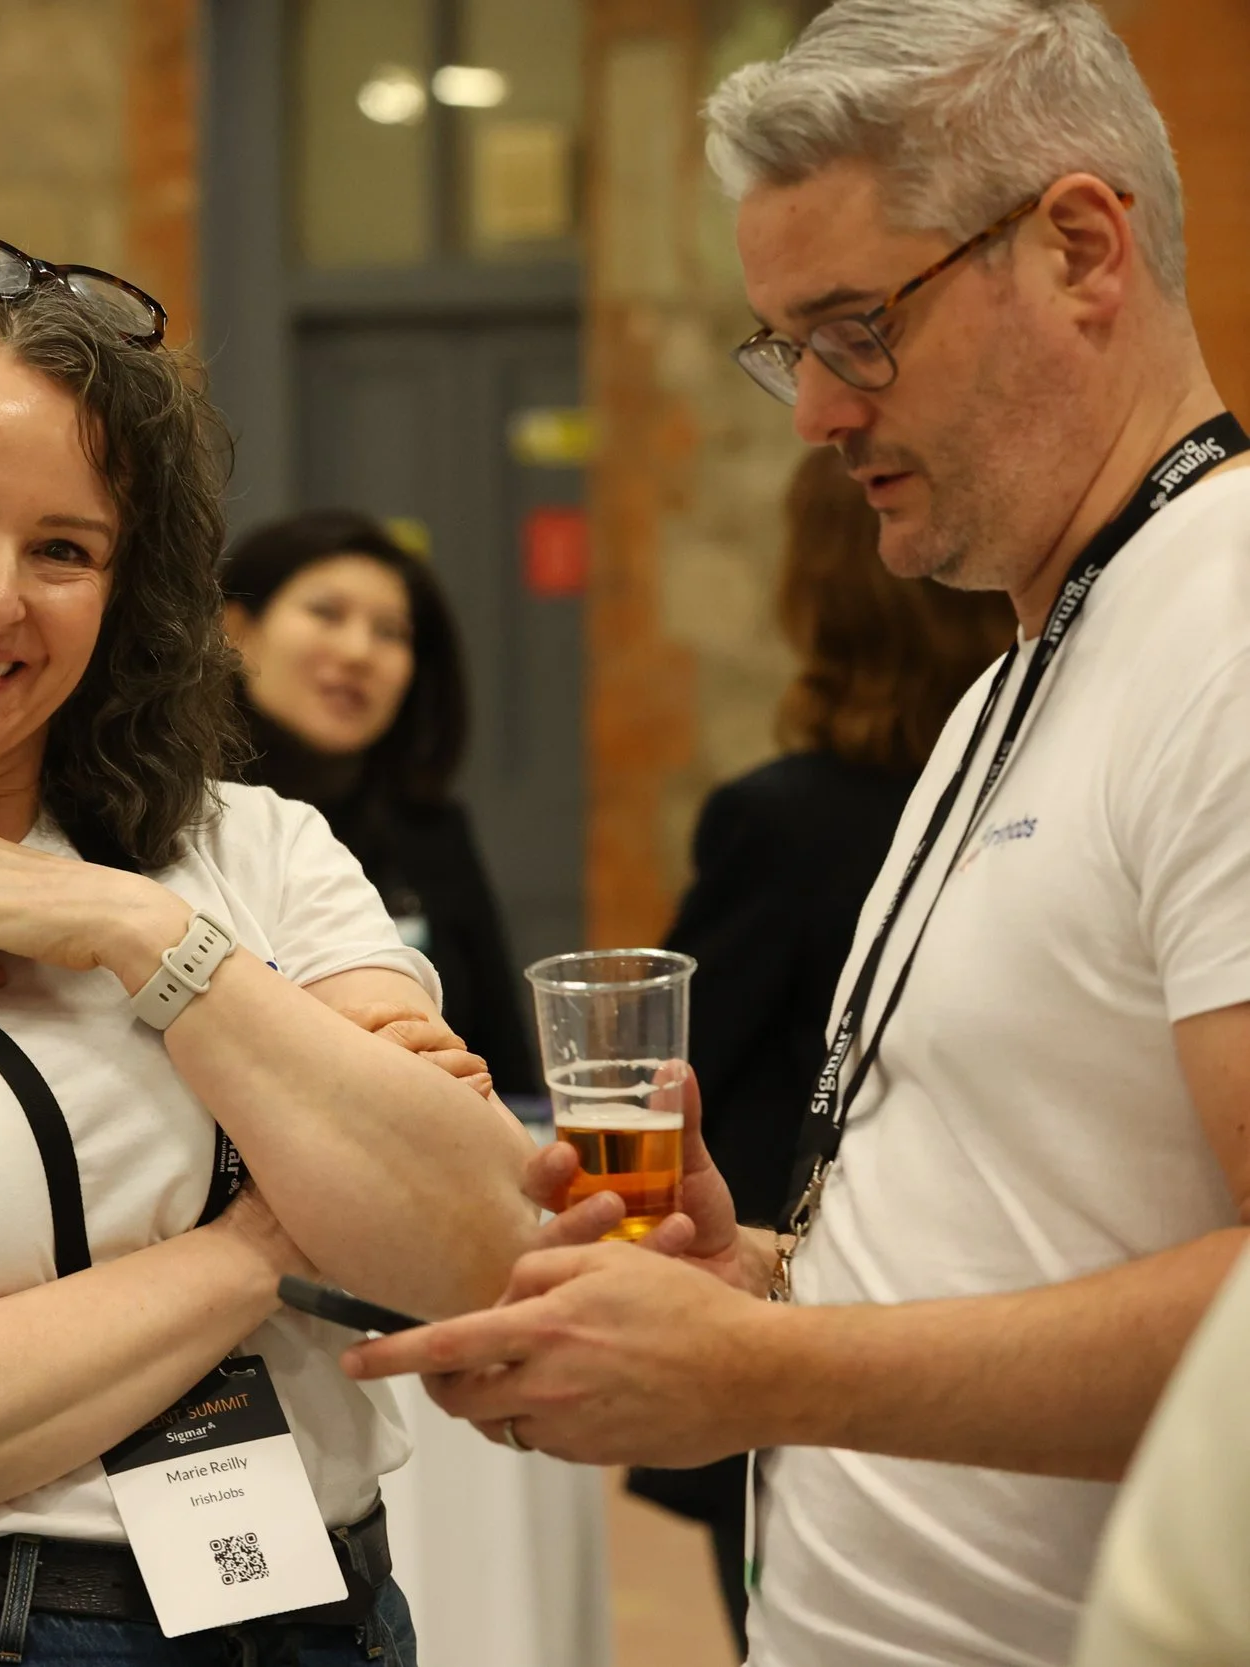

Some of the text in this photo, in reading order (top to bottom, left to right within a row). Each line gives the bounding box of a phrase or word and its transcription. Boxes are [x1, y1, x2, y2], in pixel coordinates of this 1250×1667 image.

[1158, 437, 1227, 493] Sigmar
[1048, 563, 1103, 646] Sigmar
[810, 1031, 848, 1115] Sigmar
[189, 1392, 250, 1420] SUMMIT
[166, 1425, 208, 1444] Sigmar
[166, 1457, 249, 1484] Marie Reilly
[189, 1486, 246, 1507] IrishJobs
